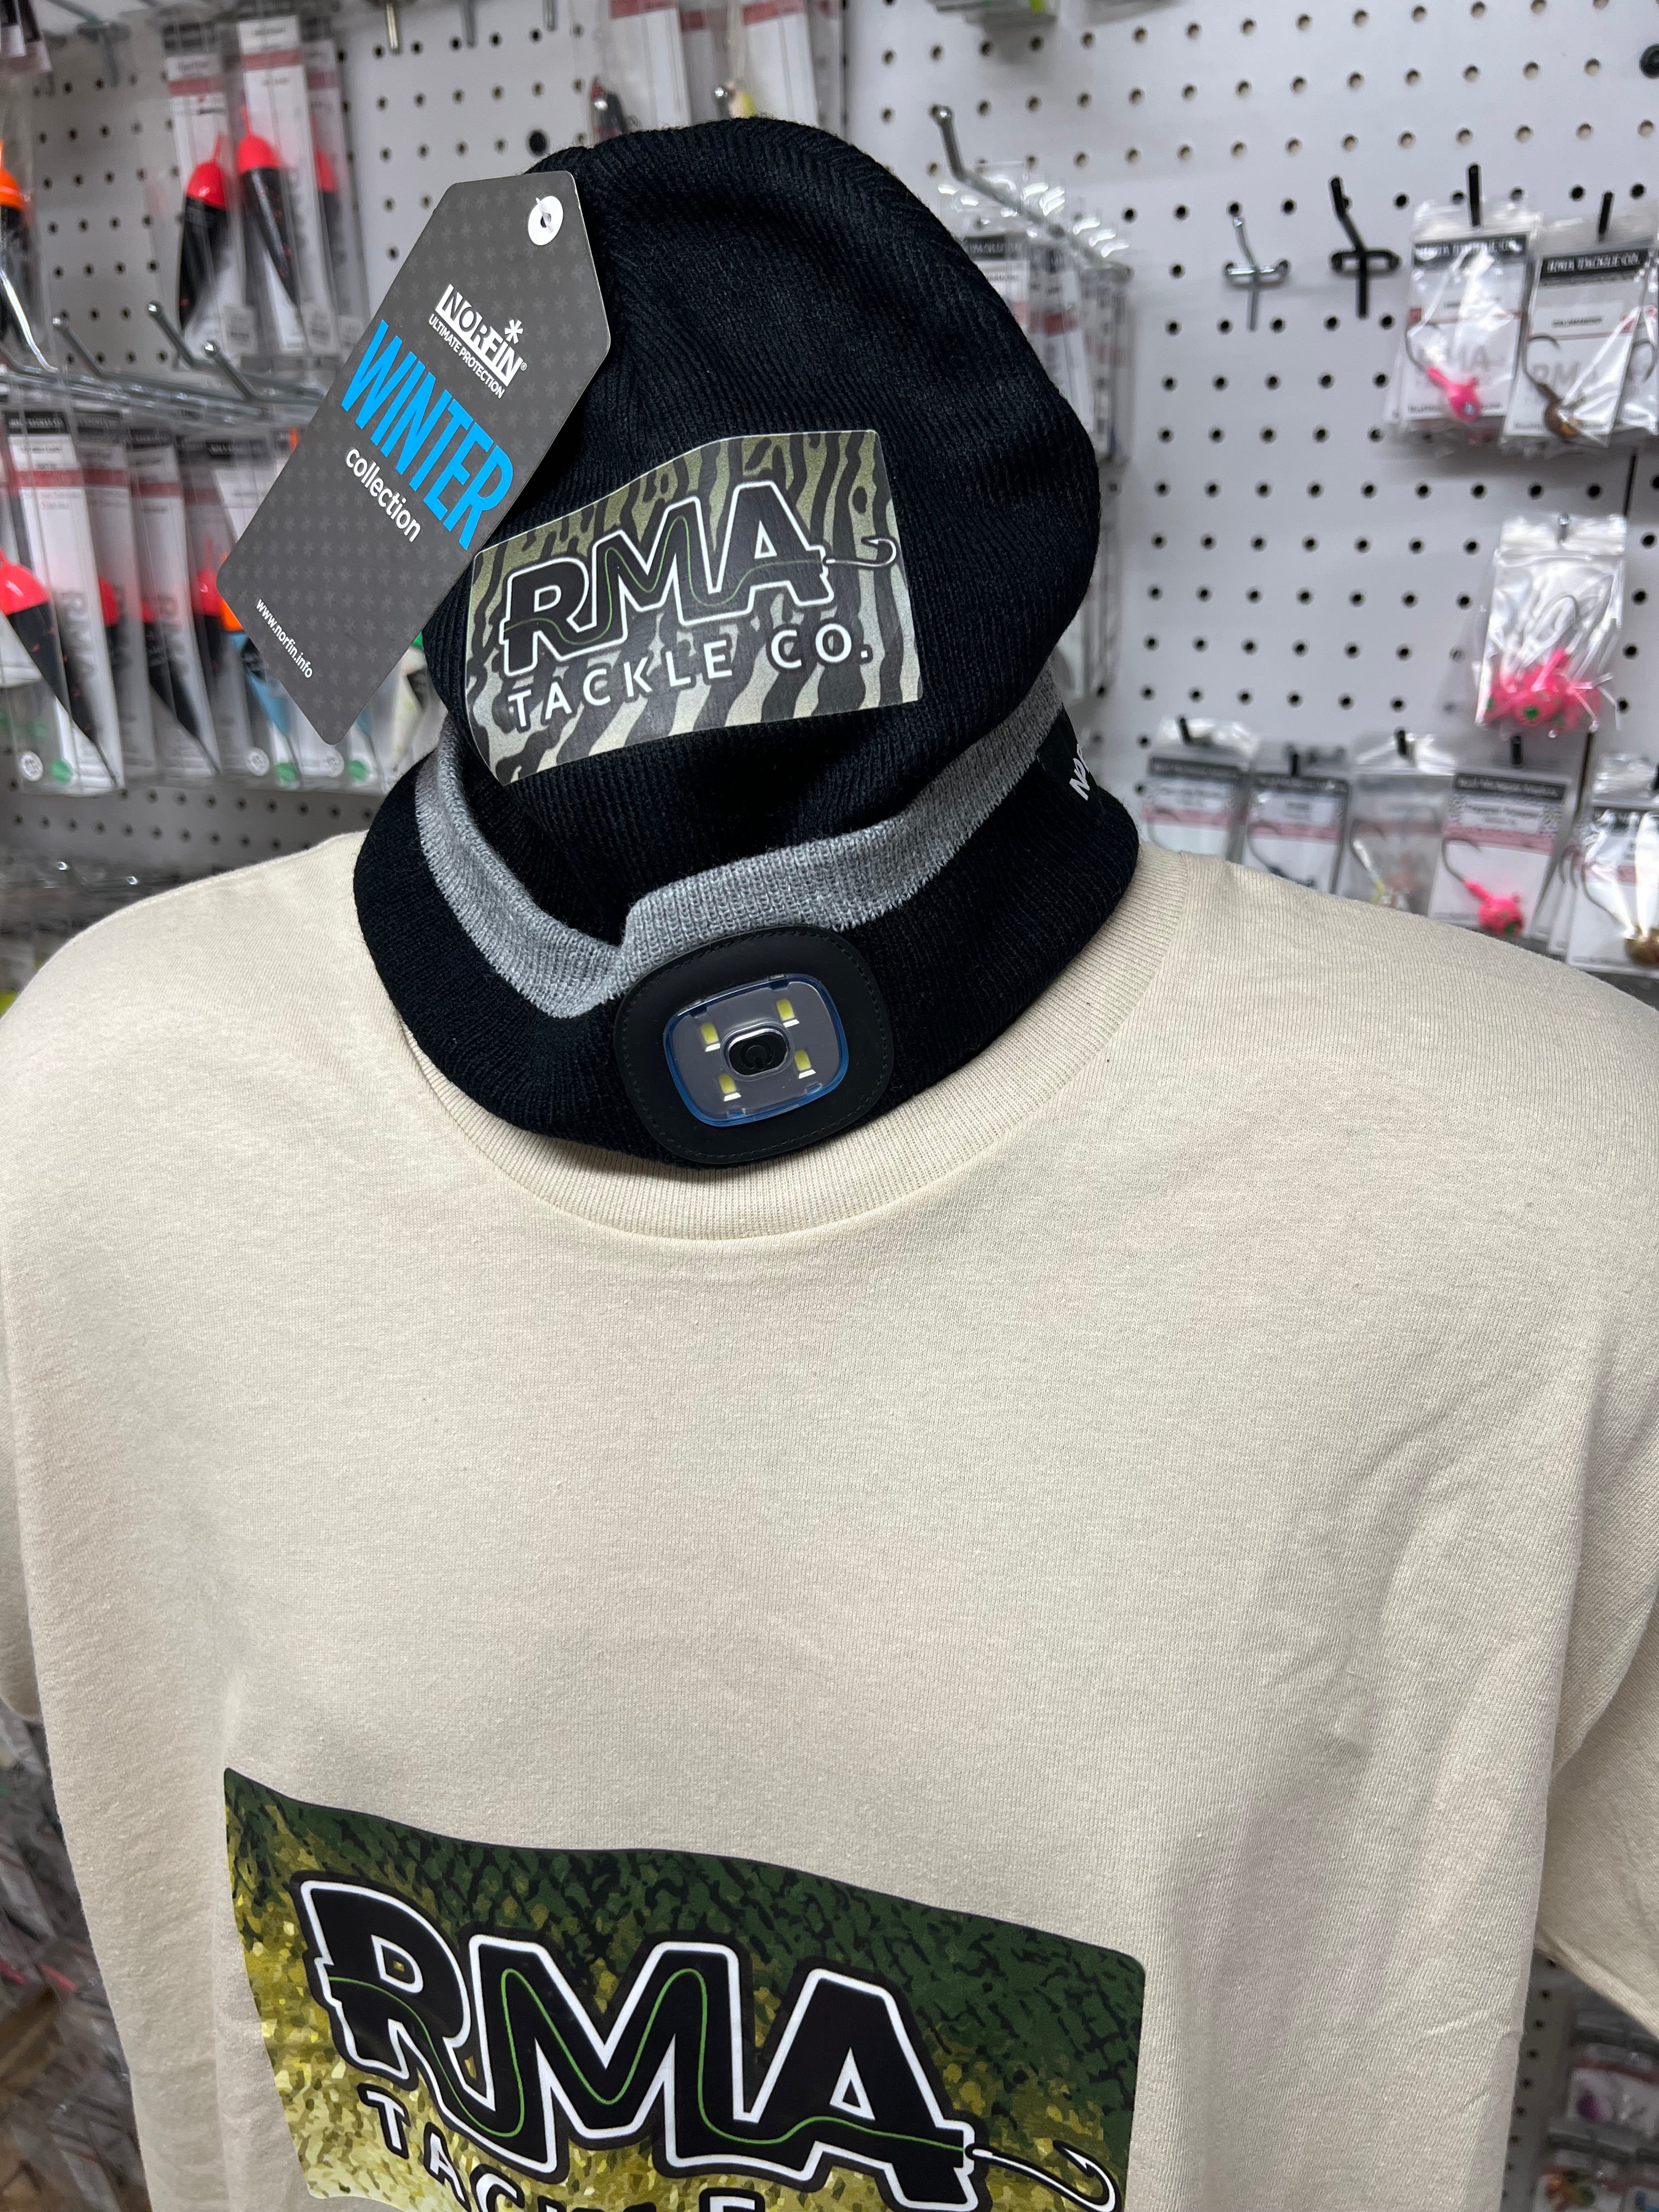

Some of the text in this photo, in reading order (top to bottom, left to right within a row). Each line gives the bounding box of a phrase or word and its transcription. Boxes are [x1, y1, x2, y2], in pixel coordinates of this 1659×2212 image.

[428, 313, 505, 399] ULTIMATE PROTECTION
[435, 284, 523, 386] NORFIN
[341, 320, 513, 550] WINTER
[346, 448, 421, 543] collection
[499, 481, 835, 677] RMA
[257, 599, 313, 678] www.norfin.info
[509, 623, 868, 727] TACKLE CO.
[300, 1880, 978, 2212] RMA
